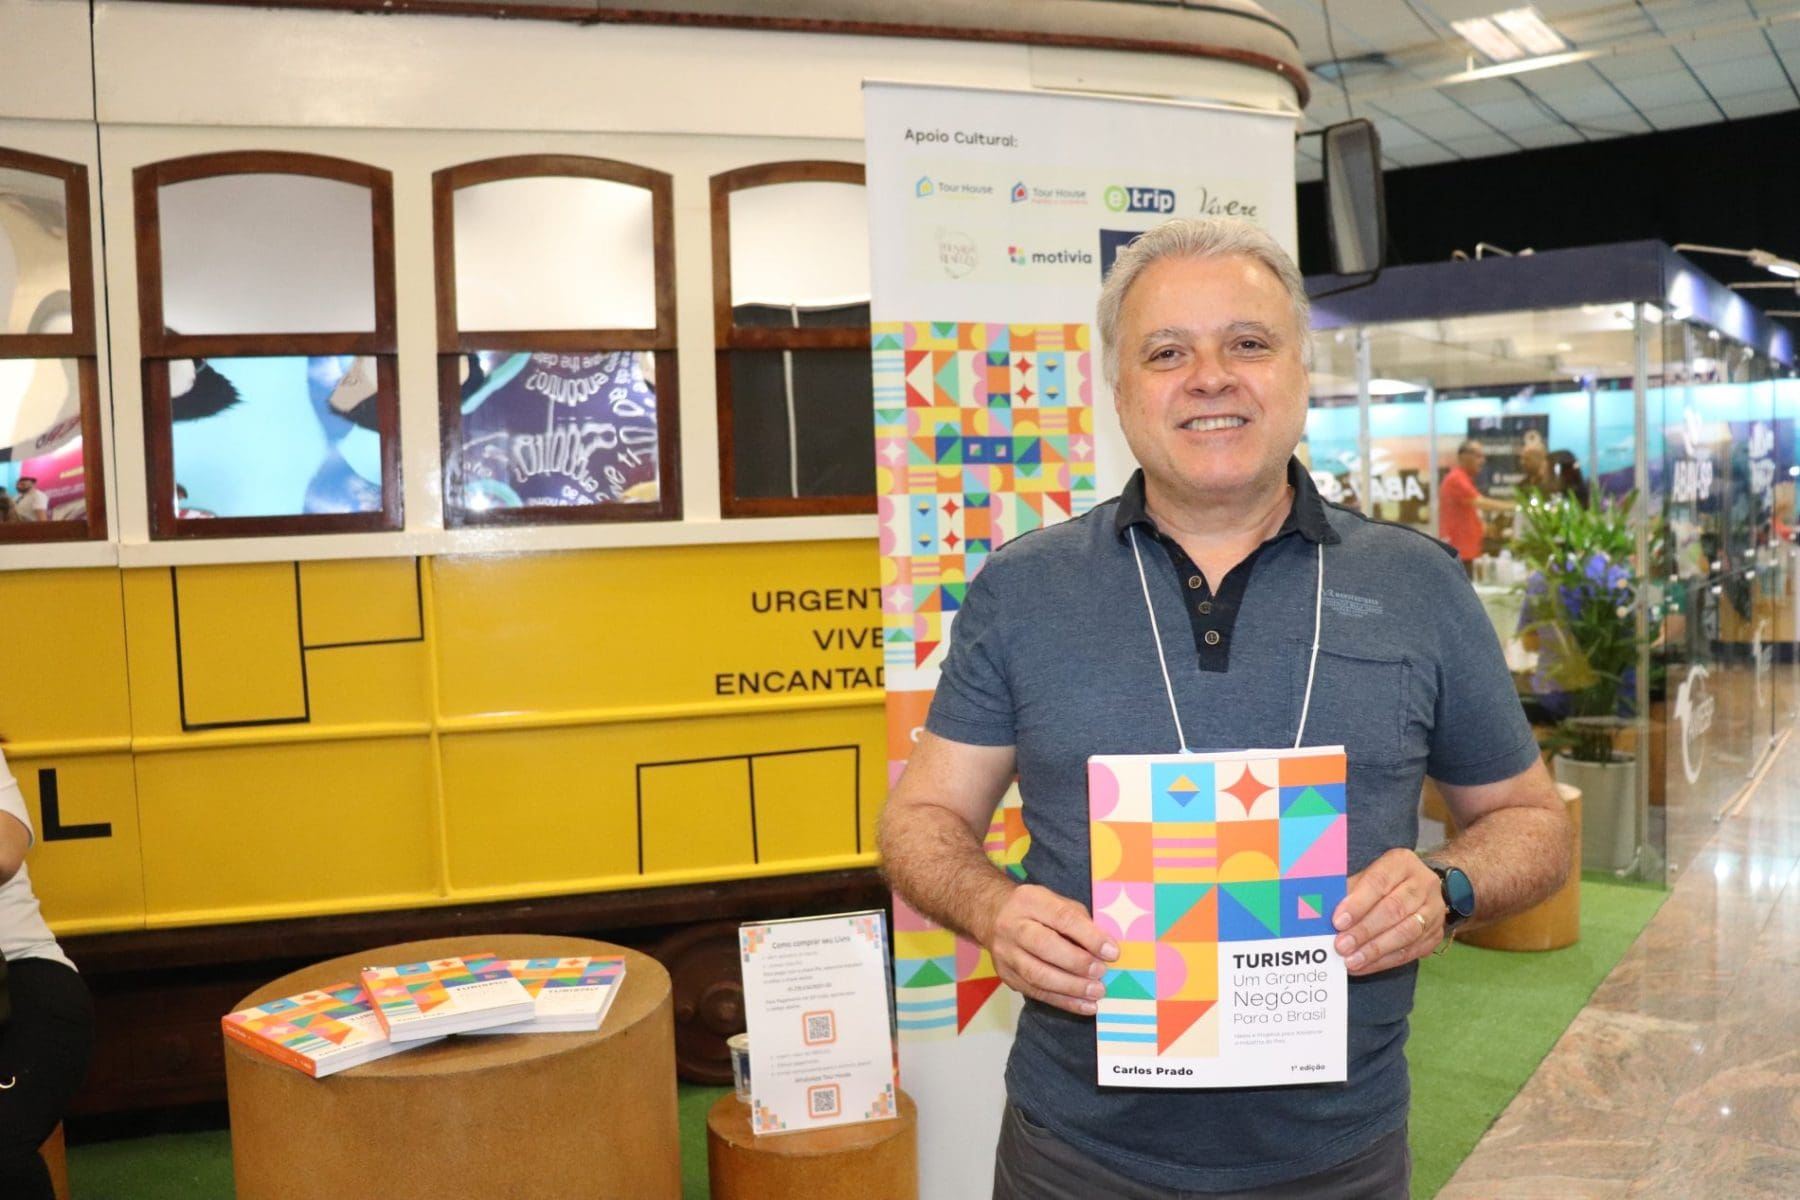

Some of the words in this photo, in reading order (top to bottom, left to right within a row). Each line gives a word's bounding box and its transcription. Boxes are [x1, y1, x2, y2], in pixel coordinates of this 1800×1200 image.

[904, 128, 950, 146] Apoio
[954, 131, 1019, 149] Cultural:
[938, 182, 961, 193] Tour
[962, 184, 994, 194] House
[1031, 249, 1093, 265] motivia
[751, 587, 883, 613] URGENT
[812, 627, 884, 651] VIVE
[1232, 948, 1328, 969] TURISMO
[1233, 974, 1260, 987] Um
[1265, 968, 1328, 986] Grande
[1233, 984, 1328, 1011] Negócio
[1233, 1012, 1269, 1025] Para
[1273, 1013, 1283, 1023] o
[1287, 1007, 1327, 1022] Brasil
[1112, 1065, 1153, 1076] Carlos
[1156, 1066, 1194, 1077] Prado
[1299, 1064, 1326, 1073] edição
